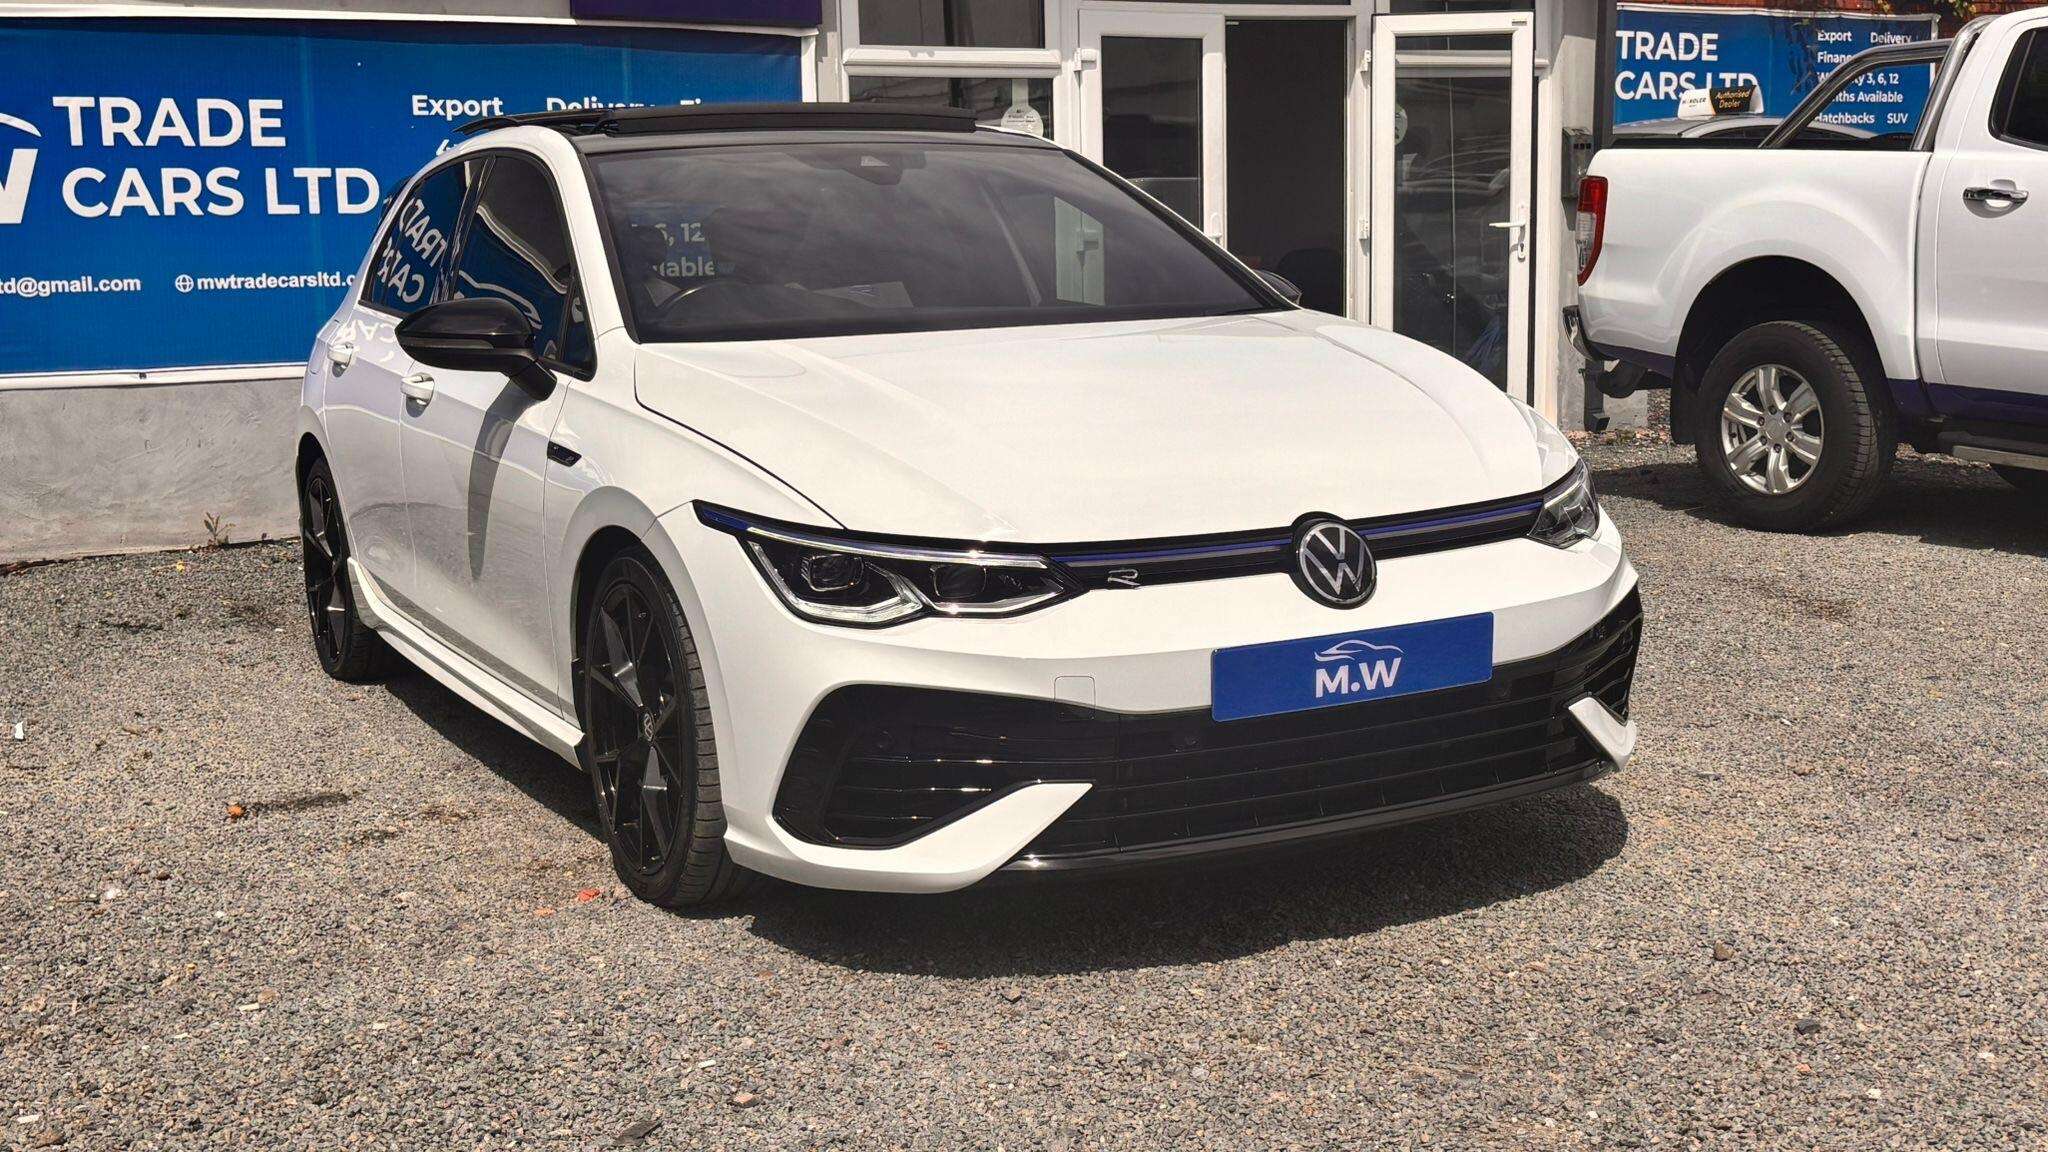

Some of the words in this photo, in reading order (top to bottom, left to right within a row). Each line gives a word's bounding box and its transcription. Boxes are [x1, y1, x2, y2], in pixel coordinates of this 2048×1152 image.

[1615, 30, 1718, 61] TRADE
[1817, 30, 1852, 43] Export
[1614, 70, 1698, 100] CARS
[1867, 73, 1875, 85] 3,
[1877, 73, 1887, 85] 6,
[1888, 73, 1899, 84] 12
[411, 94, 503, 120] Export
[1857, 91, 1903, 102] Available
[52, 96, 287, 147] TRADE
[1887, 113, 1908, 124] SUV
[62, 166, 245, 218] CARS
[264, 167, 381, 215] LTD
[680, 222, 705, 242] 12
[1315, 657, 1402, 699] M.W
